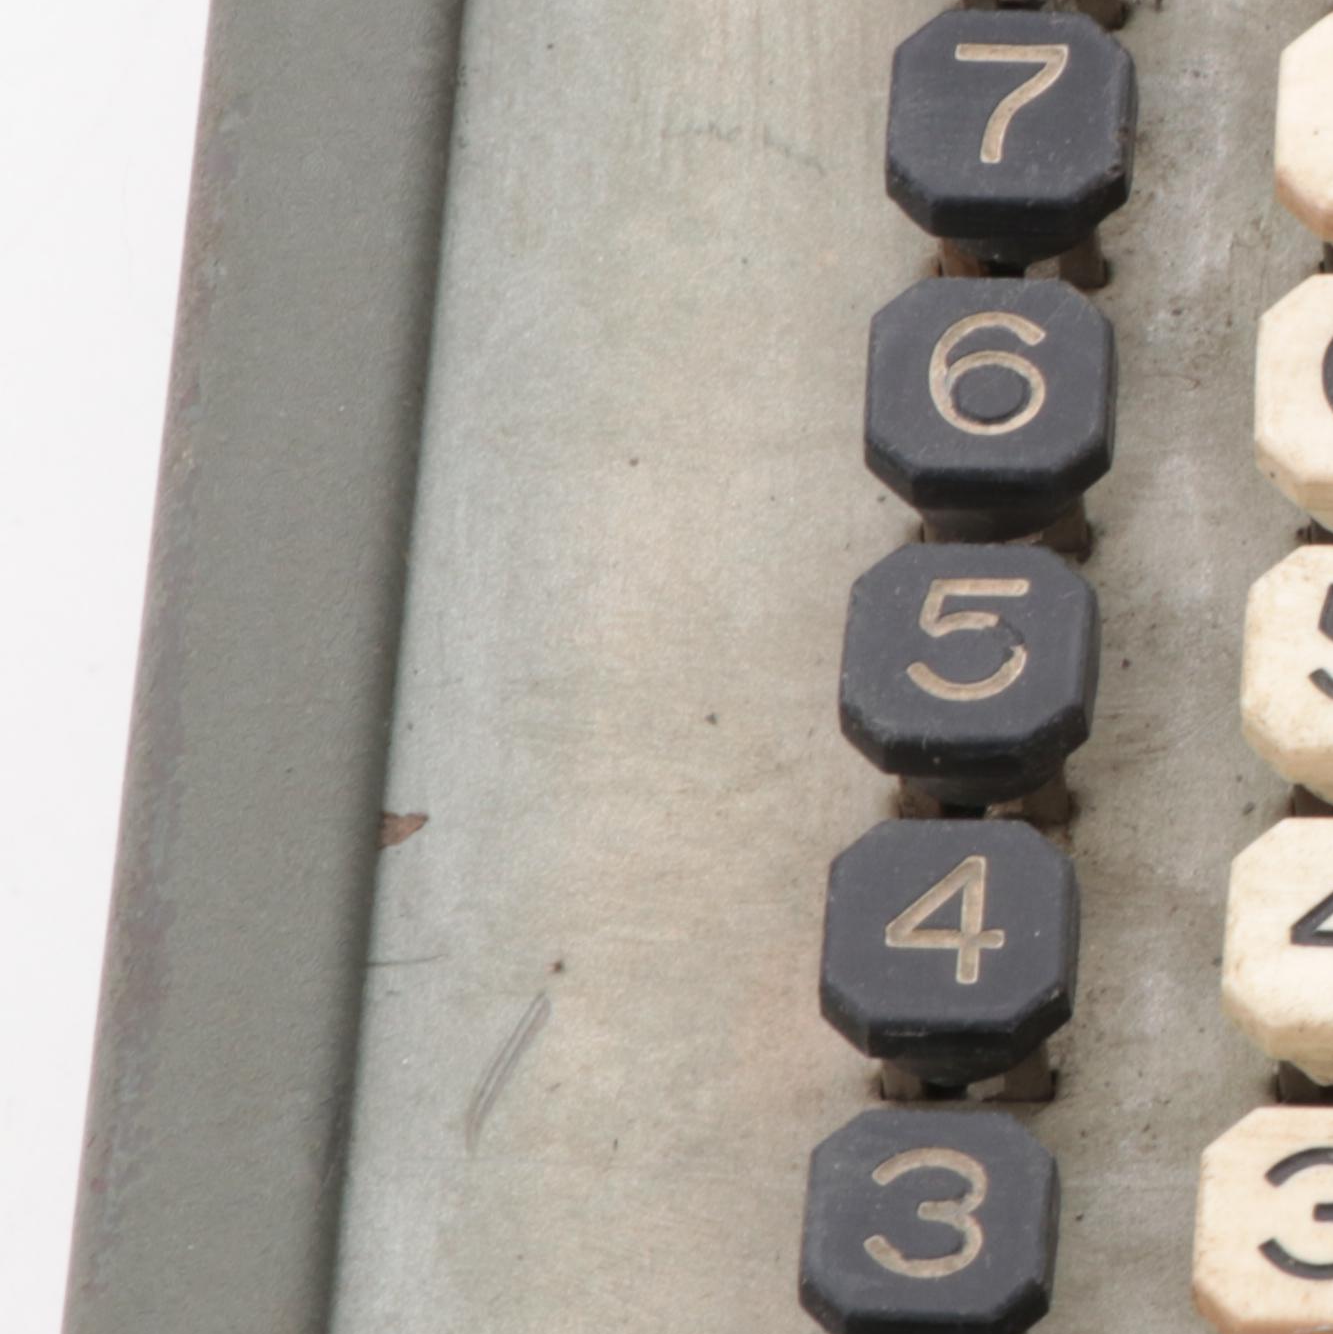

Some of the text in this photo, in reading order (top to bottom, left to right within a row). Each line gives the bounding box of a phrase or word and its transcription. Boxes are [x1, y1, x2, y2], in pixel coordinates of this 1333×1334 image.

[954, 43, 1069, 163] 7
[929, 311, 1047, 436] 6
[906, 578, 1029, 701] 5
[885, 855, 1005, 984] 4
[863, 1147, 988, 1279] 3
